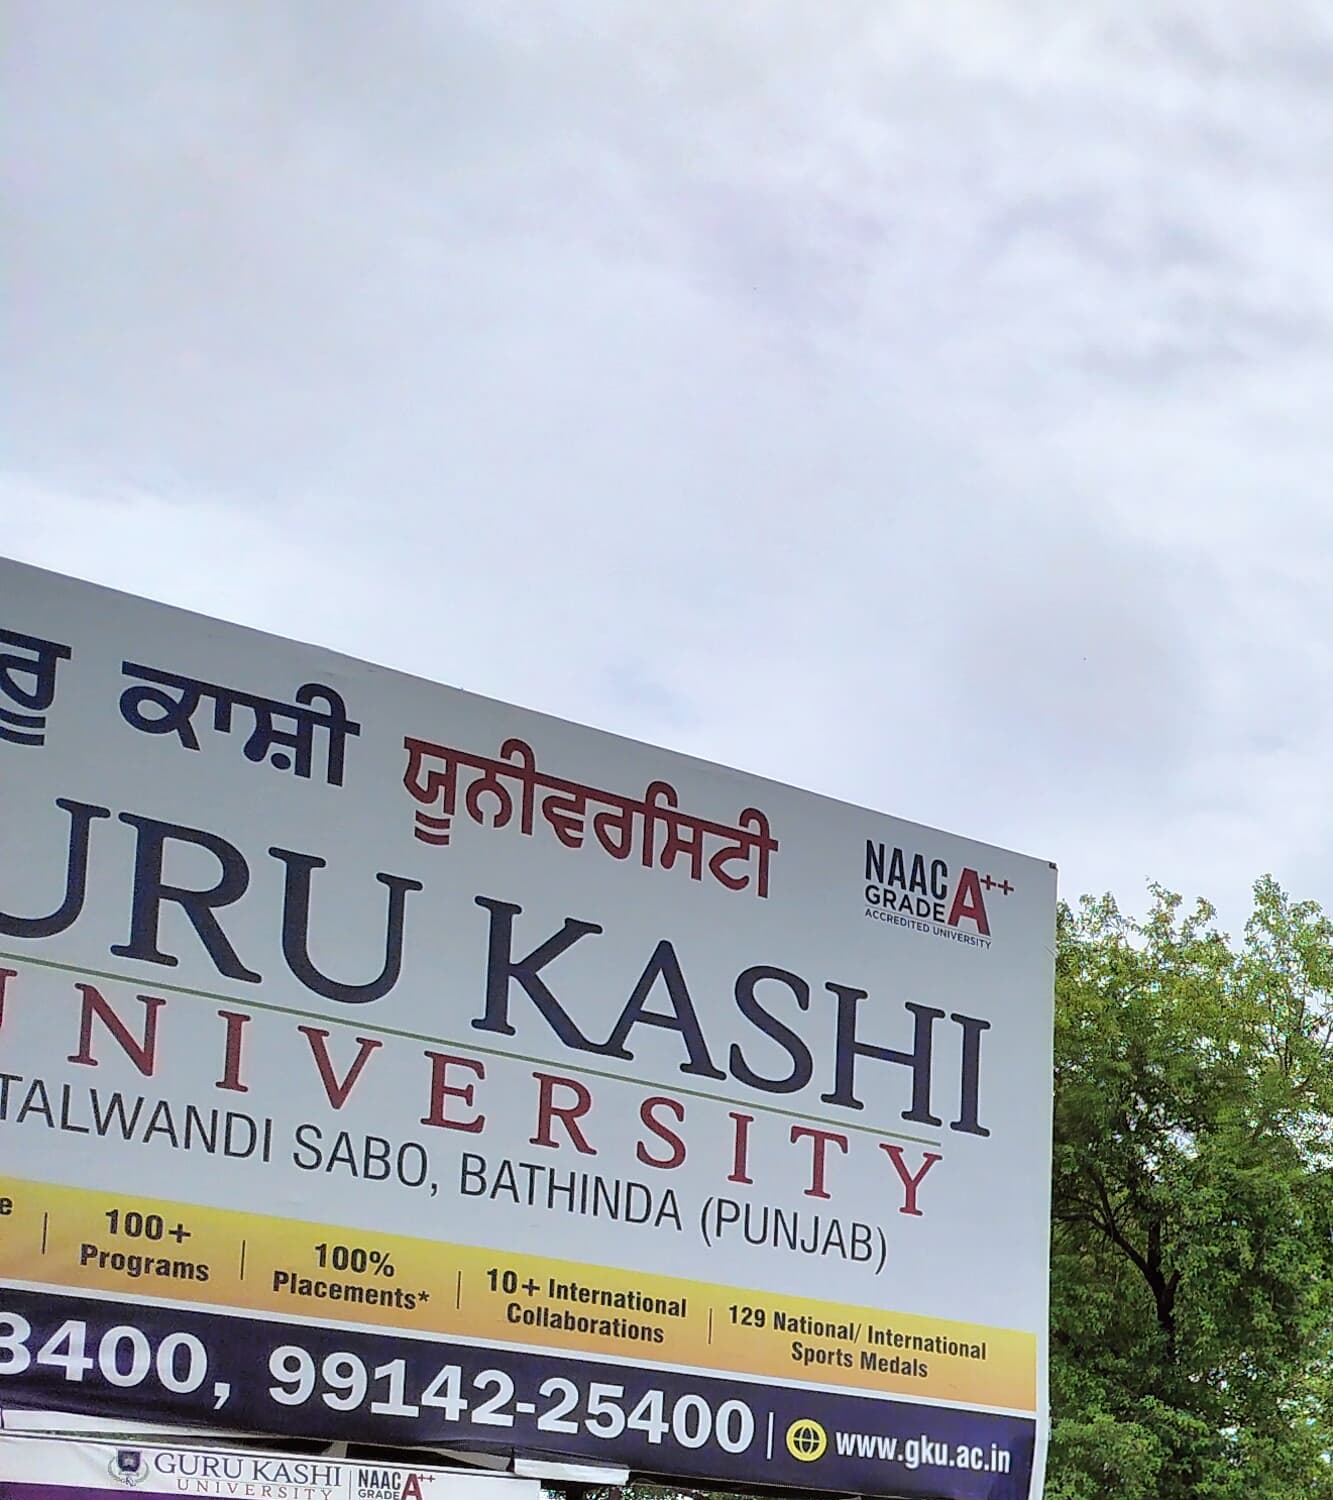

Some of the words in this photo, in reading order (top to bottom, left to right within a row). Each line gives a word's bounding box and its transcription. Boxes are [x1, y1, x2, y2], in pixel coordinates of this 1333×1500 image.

[119, 660, 361, 788] ਕਾਸ਼ੀ
[403, 736, 779, 899] ਯੂਨੀਵਰਸਿਟੀ
[865, 839, 949, 901] NAAC
[865, 884, 946, 924] GRADE
[947, 867, 1015, 937] A++
[864, 908, 931, 933] ACCREDITED
[932, 927, 993, 951] UNIVERSITY
[471, 895, 992, 1138] KASHI
[0, 968, 943, 1217] NIVERSITY
[293, 1123, 438, 1198] SABO,
[460, 1152, 683, 1231] BATHINDA
[700, 1196, 888, 1275] (PUNJAB)
[104, 1208, 191, 1244] 100+
[80, 1243, 210, 1282] Programs
[315, 1243, 395, 1278] 100%
[487, 1267, 541, 1298] 10+
[548, 1278, 688, 1318] International
[506, 1302, 665, 1345] Collaborations
[728, 1304, 766, 1329] 129
[772, 1310, 863, 1343] National/
[867, 1324, 987, 1362] International
[790, 1340, 853, 1368] Sports
[860, 1350, 928, 1378] Medals
[268, 1344, 755, 1453] 99142-25400
[154, 1452, 243, 1478] GURU
[252, 1459, 341, 1488] KASHI
[834, 1428, 1011, 1474] www.gku.ac.in
[357, 1468, 401, 1491] NAAC
[357, 1488, 401, 1500] GRADE
